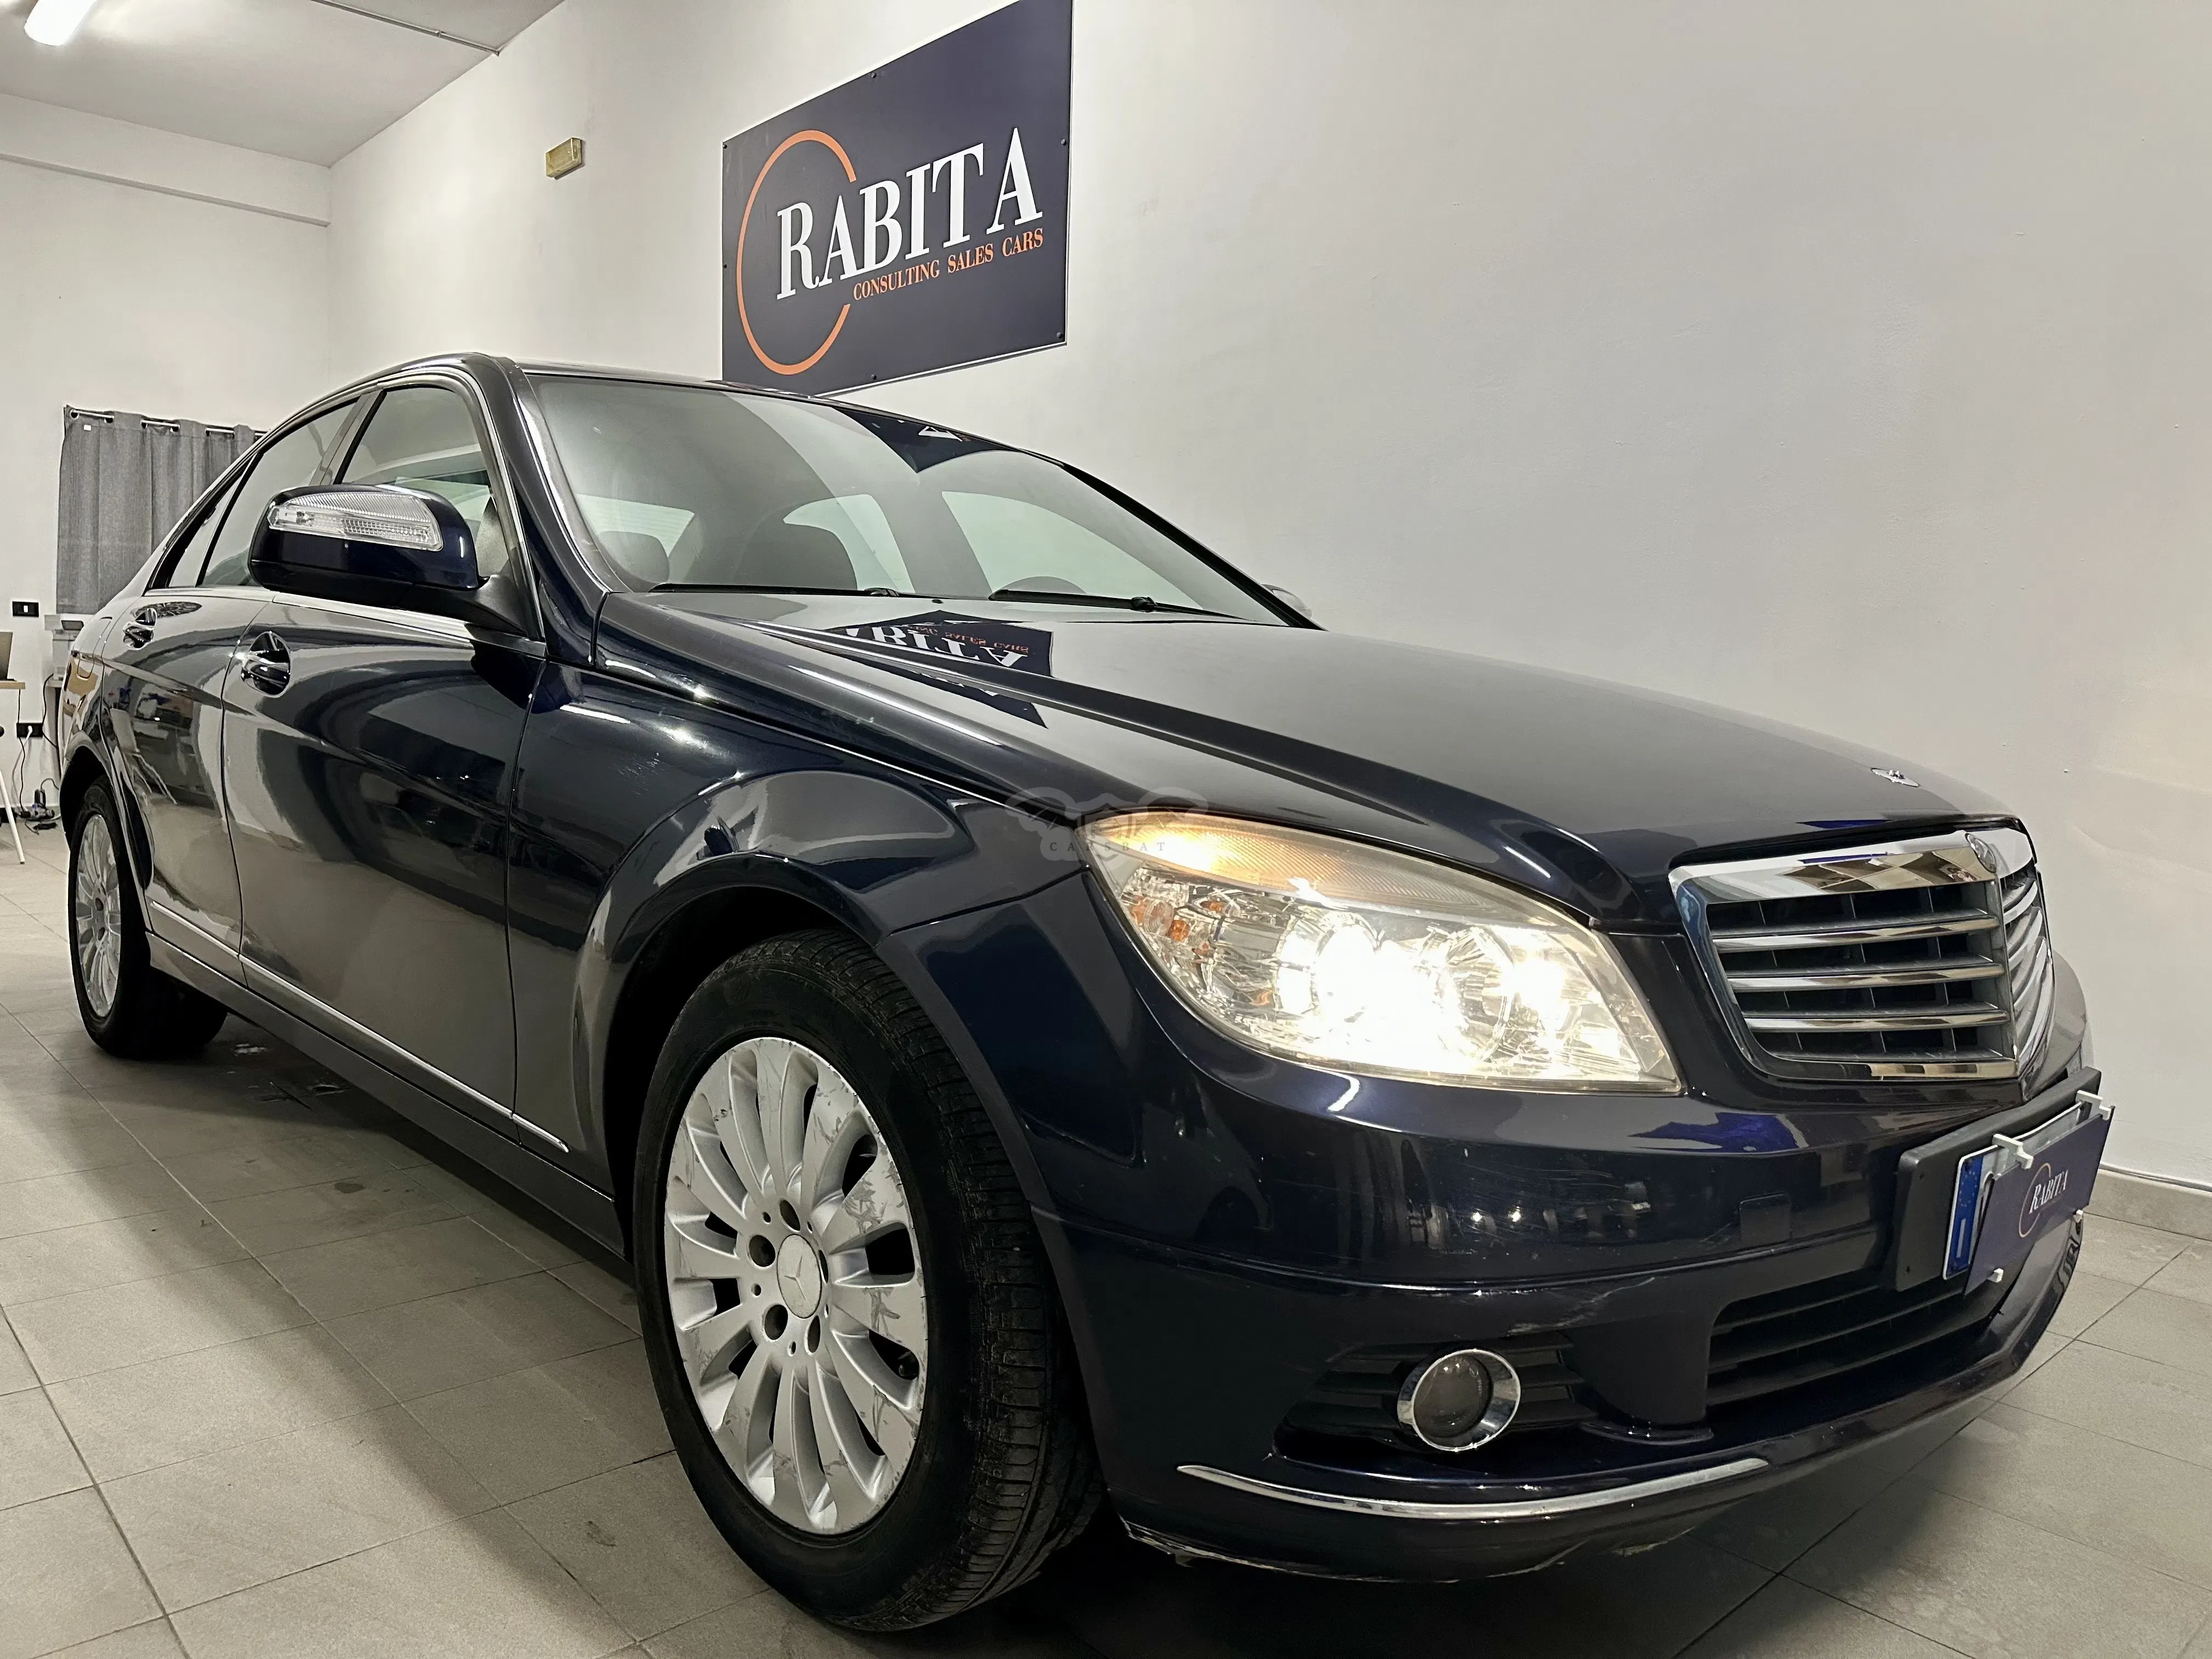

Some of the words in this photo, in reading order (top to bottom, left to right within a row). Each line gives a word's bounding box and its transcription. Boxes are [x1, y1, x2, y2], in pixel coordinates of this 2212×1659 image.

[777, 127, 1043, 300] RABITA
[853, 259, 940, 301] CONSULTING
[947, 242, 994, 274] SALES
[1002, 228, 1043, 257] CARS
[2029, 1169, 2068, 1214] RABITA
